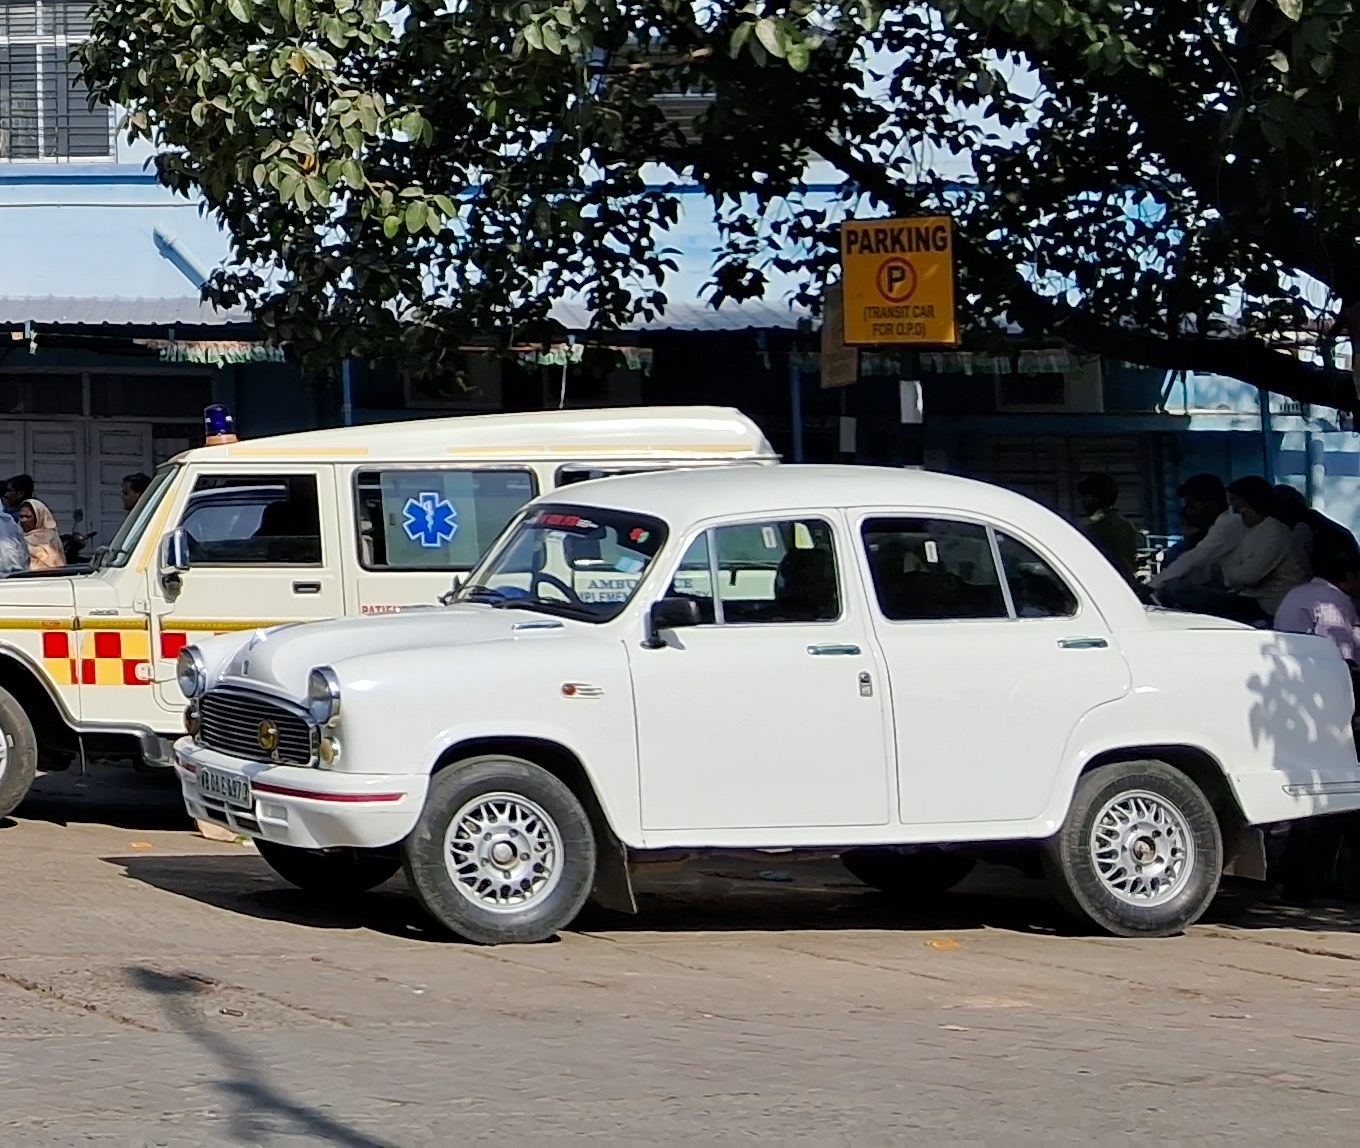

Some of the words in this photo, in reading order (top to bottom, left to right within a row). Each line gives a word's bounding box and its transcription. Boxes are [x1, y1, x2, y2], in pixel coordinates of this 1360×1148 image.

[846, 226, 947, 255] PARKING
[913, 304, 935, 318] CAR
[873, 324, 894, 336] FOR
